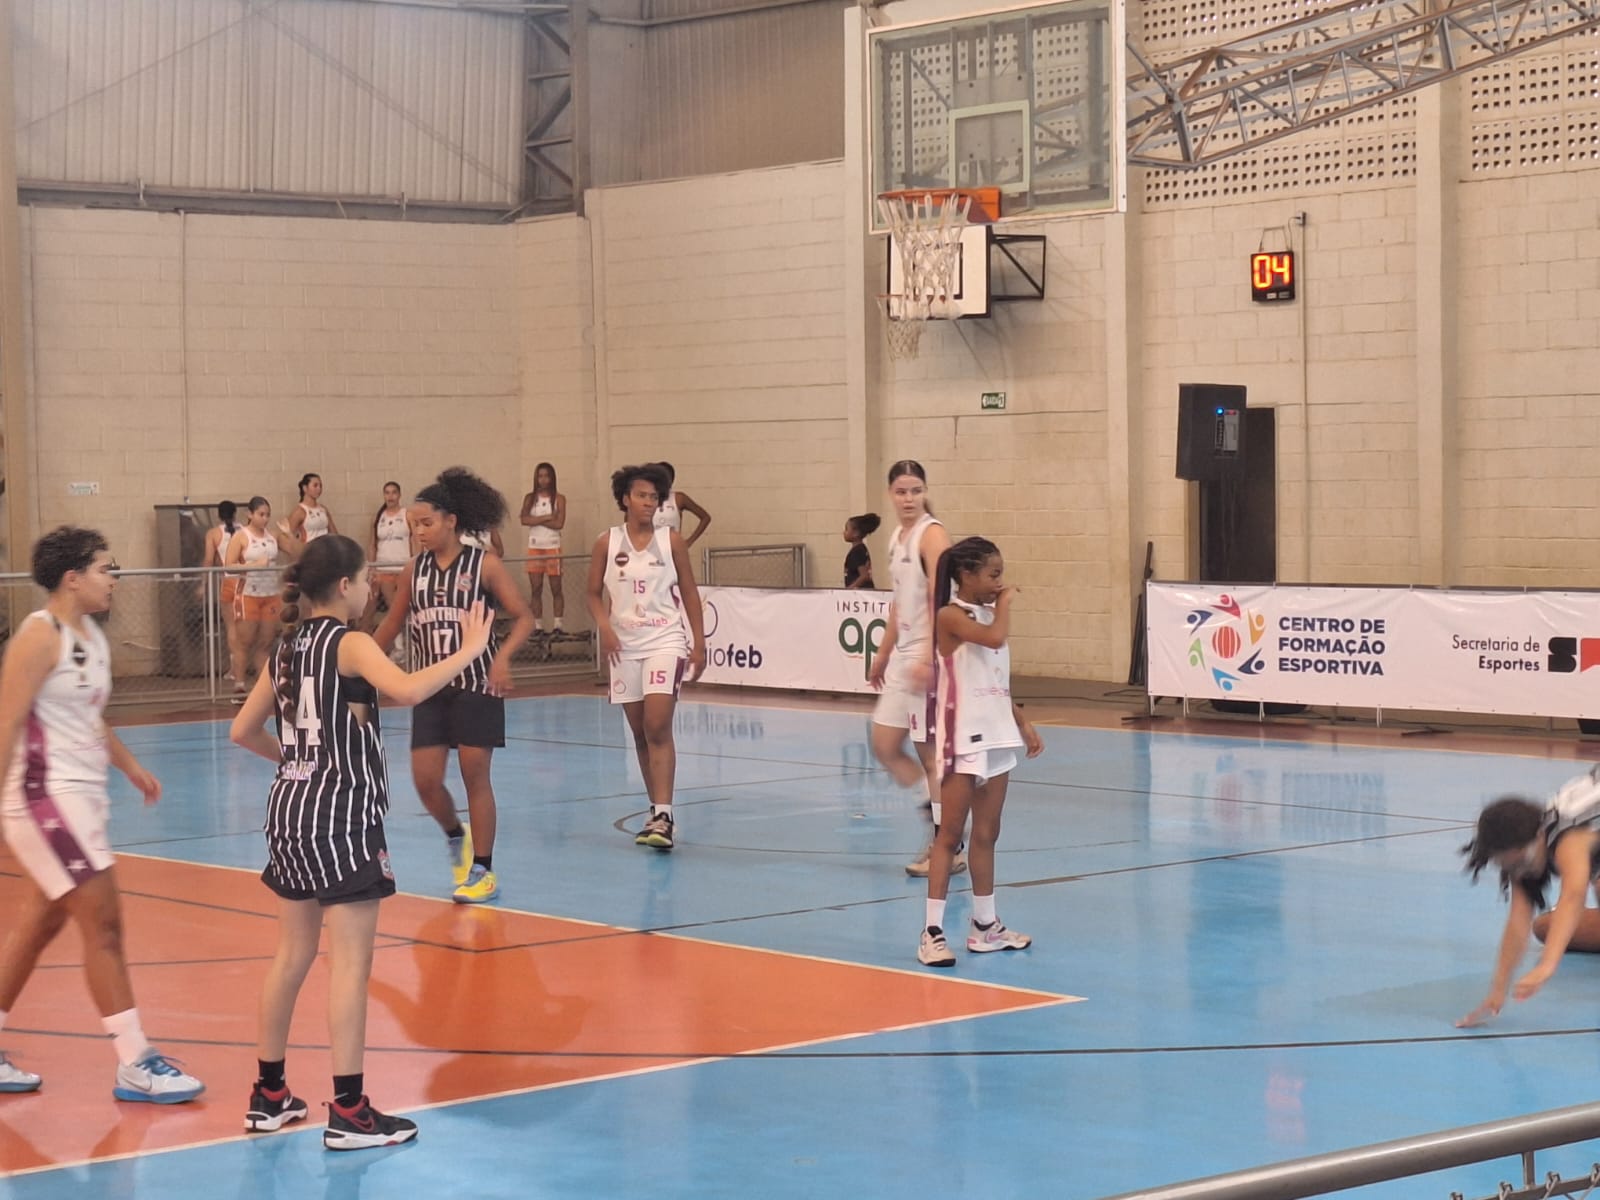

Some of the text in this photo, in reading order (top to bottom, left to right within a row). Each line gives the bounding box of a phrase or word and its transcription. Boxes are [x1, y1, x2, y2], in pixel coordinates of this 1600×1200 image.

[1254, 255, 1290, 288] 04
[633, 579, 646, 594] 15
[836, 601, 892, 614] INSTIT
[1279, 616, 1386, 634] CENTRO DE
[432, 628, 454, 654] 17
[1278, 635, 1386, 657] FORMAÇÃO
[1452, 634, 1540, 652] Secretaria de
[703, 643, 763, 669] iofeb
[1478, 655, 1540, 674] Esportes
[1278, 657, 1384, 676] ESPORTIVA
[649, 670, 667, 685] 15
